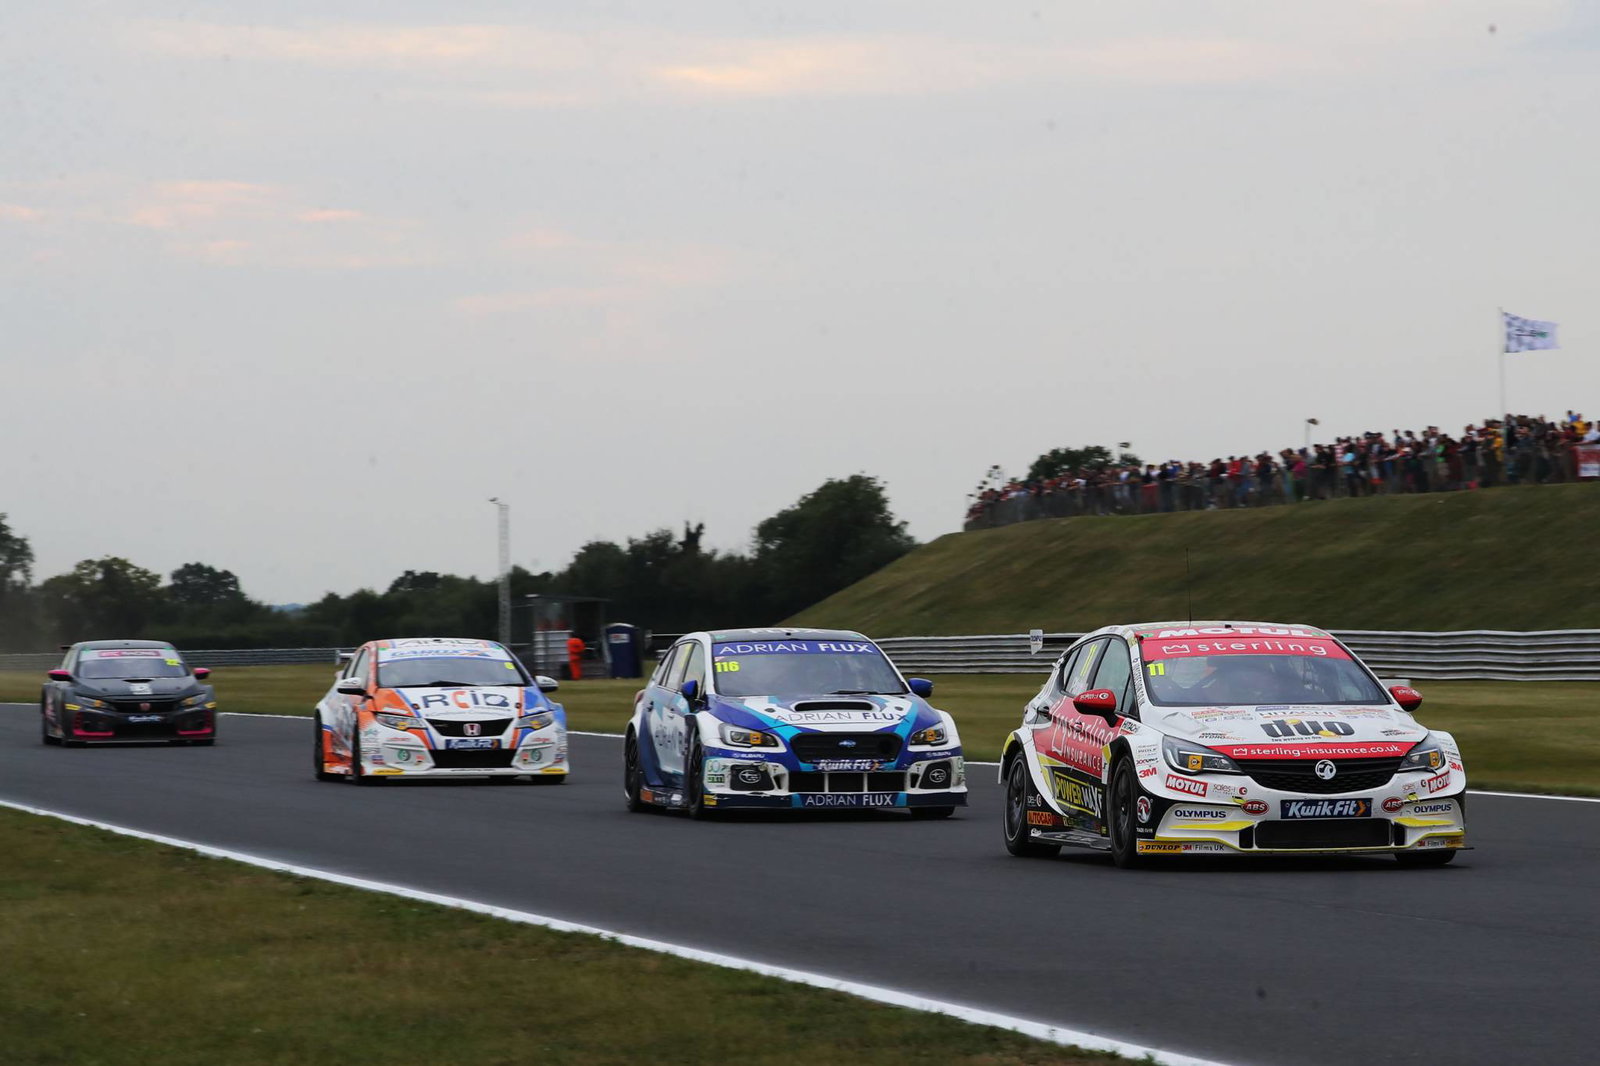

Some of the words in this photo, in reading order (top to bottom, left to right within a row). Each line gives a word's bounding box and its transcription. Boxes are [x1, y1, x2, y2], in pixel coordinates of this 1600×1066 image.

[1158, 627, 1312, 638] MOTUL
[719, 643, 809, 655] ADRIAN
[818, 642, 873, 653] FLUX
[1197, 641, 1328, 655] sterling
[715, 661, 740, 673] 116
[1147, 662, 1165, 676] 11
[774, 712, 852, 724] ADRIAN
[863, 711, 910, 724] FLUX
[1260, 718, 1355, 739] duo
[1249, 744, 1401, 757] sterling-insurance.co.uk
[1063, 744, 1102, 771] INSURANCE
[1138, 767, 1158, 779] 3M
[1167, 777, 1206, 795] MOTUL
[805, 795, 856, 806] ADRIAN
[863, 794, 893, 806] FLUX
[1174, 809, 1227, 818] OLYMPUS
[1245, 803, 1265, 811] ABS
[1414, 803, 1452, 813] OLYMPUS
